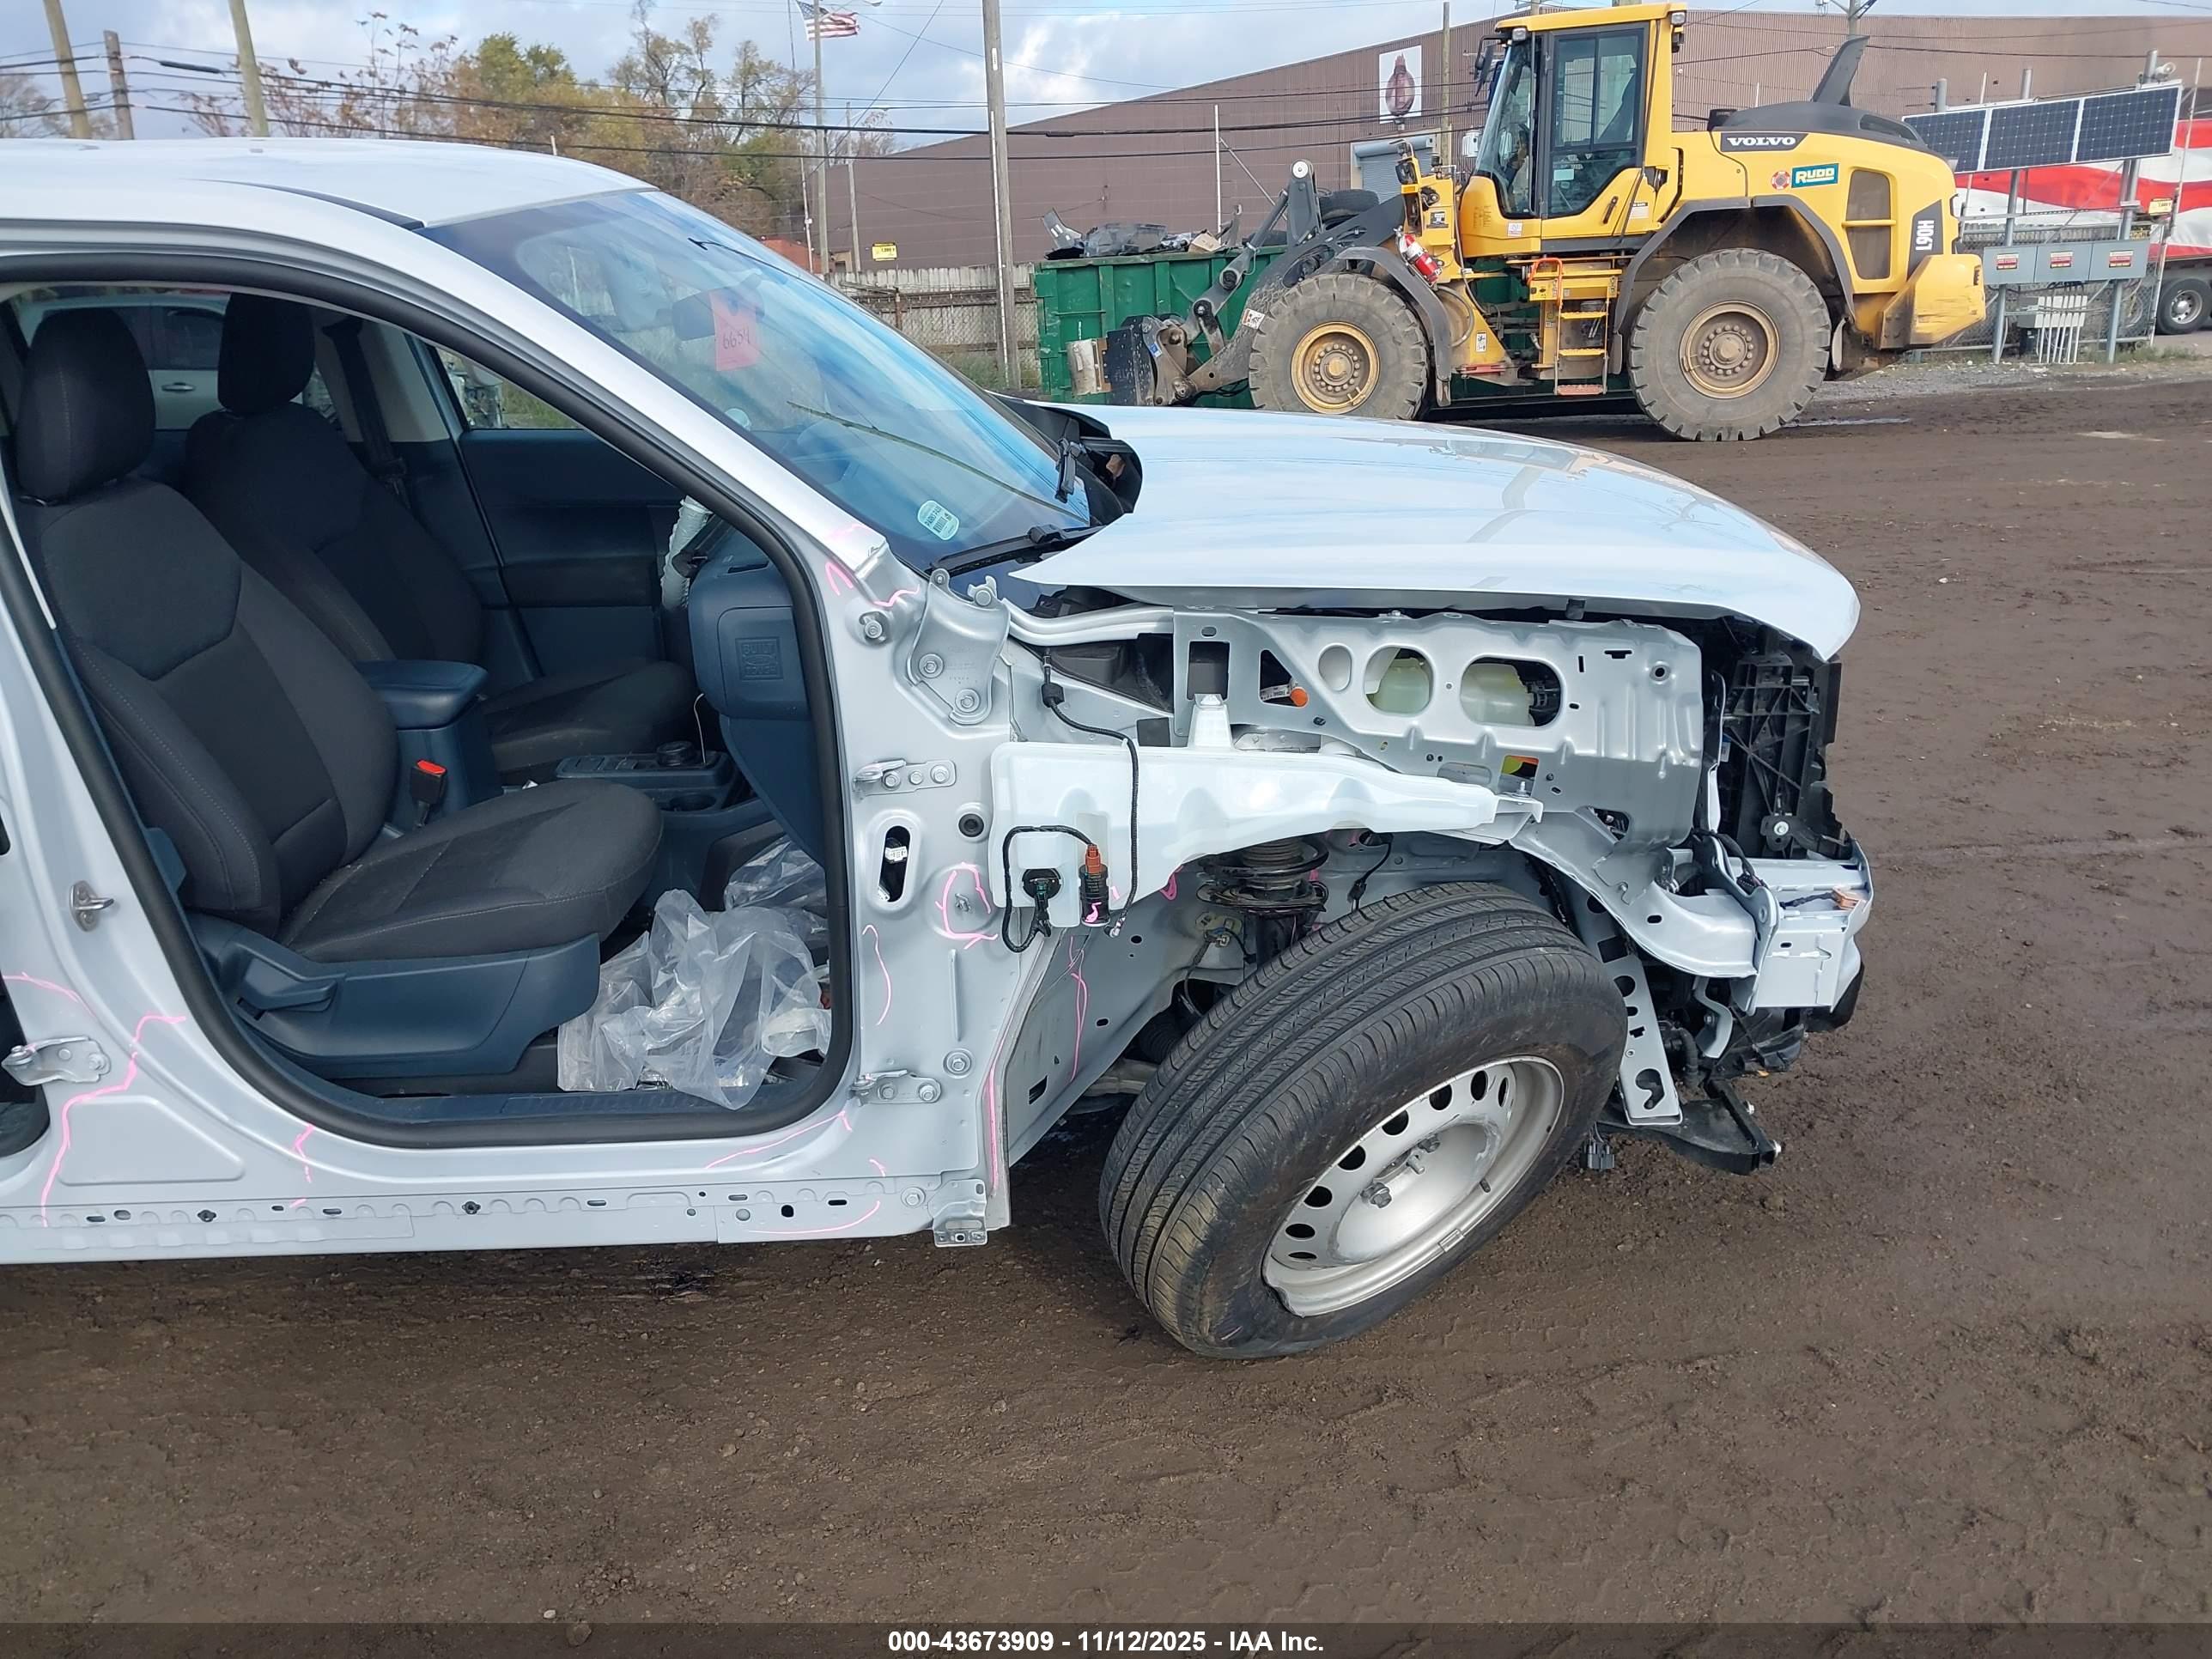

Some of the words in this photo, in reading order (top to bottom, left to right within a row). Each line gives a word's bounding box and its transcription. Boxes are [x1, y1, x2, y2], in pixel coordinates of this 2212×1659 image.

[1727, 137, 1796, 146] VOLVO
[1795, 167, 1835, 184] RUDD
[1915, 220, 1935, 251] L90H
